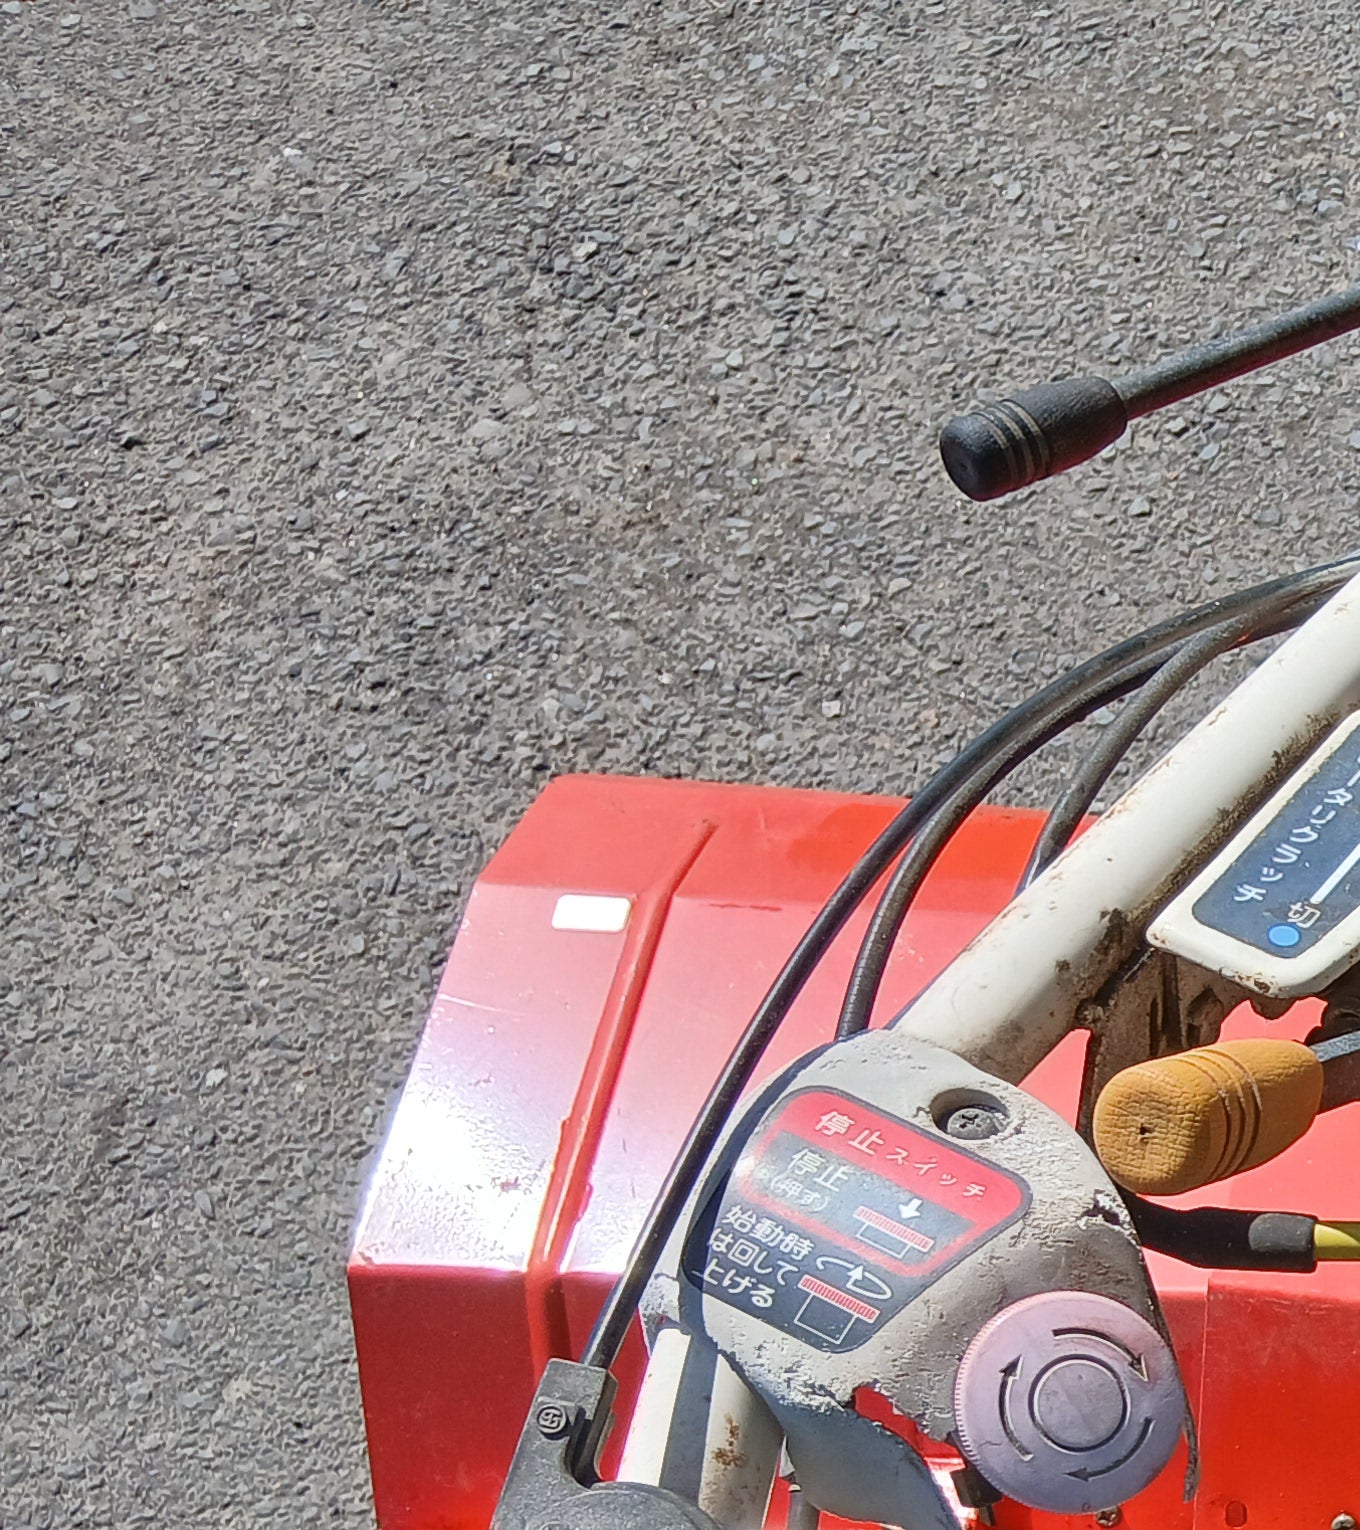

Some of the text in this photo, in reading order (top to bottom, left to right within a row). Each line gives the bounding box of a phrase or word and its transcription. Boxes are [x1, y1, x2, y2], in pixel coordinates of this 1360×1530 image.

[1287, 902, 1322, 928] 切
[789, 1147, 850, 1193] 停止
[708, 1228, 801, 1286] は回して
[722, 1204, 816, 1261] 始動時
[691, 1258, 774, 1309] 上げる
